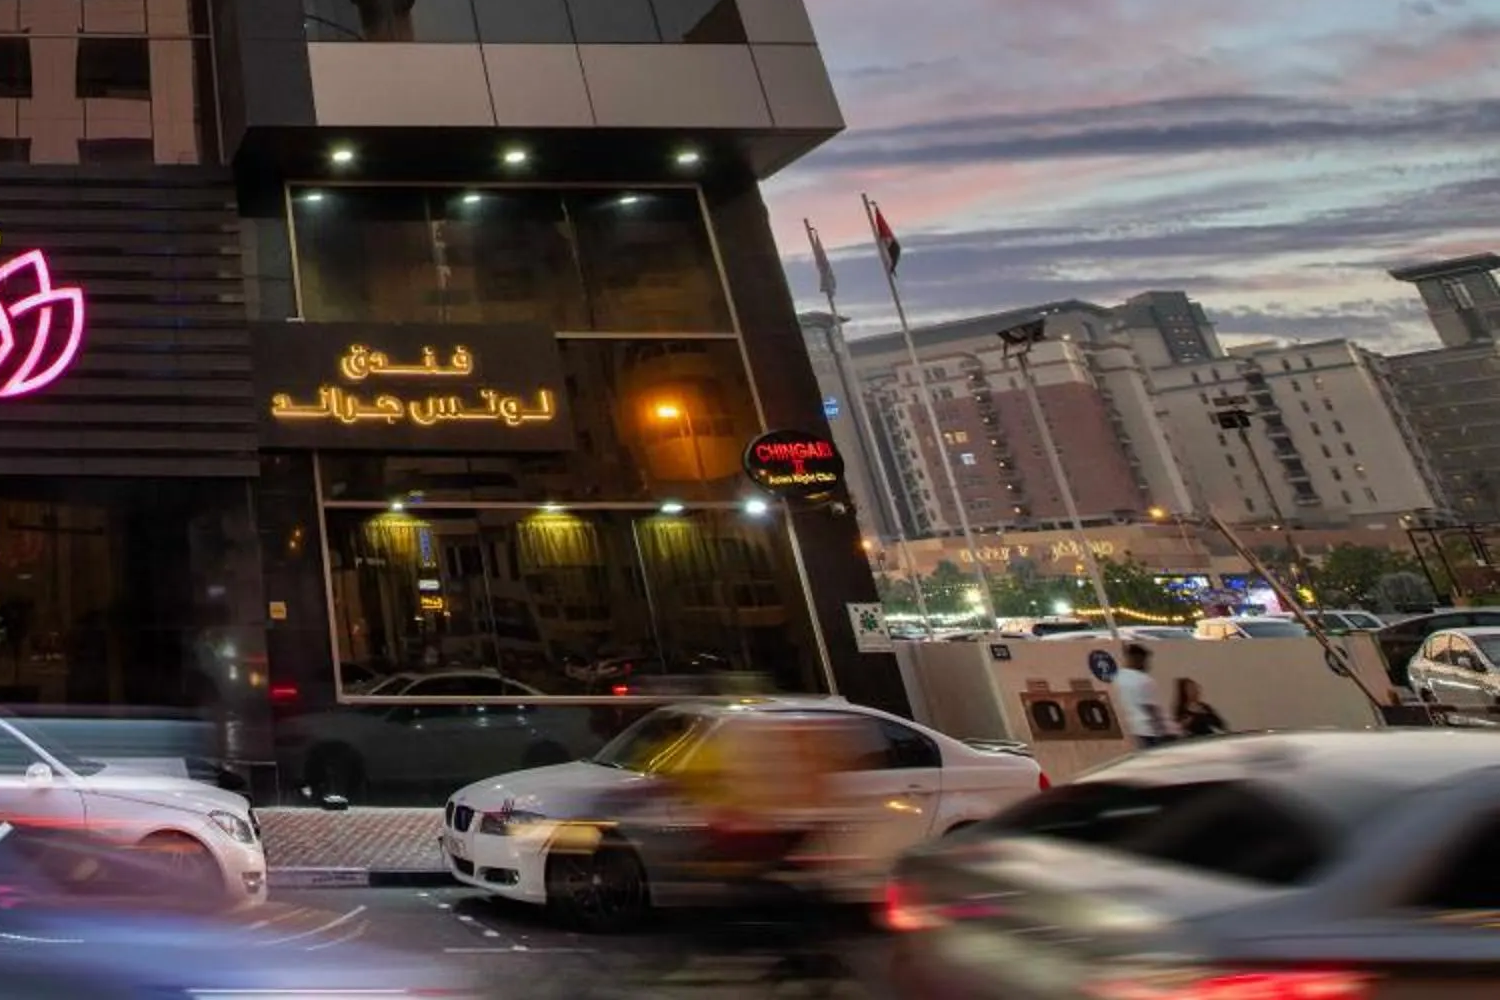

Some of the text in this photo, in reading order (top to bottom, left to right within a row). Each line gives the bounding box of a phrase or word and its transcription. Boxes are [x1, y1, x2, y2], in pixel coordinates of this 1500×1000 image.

[341, 344, 473, 379] فندق
[271, 386, 555, 425] لوتس جراند
